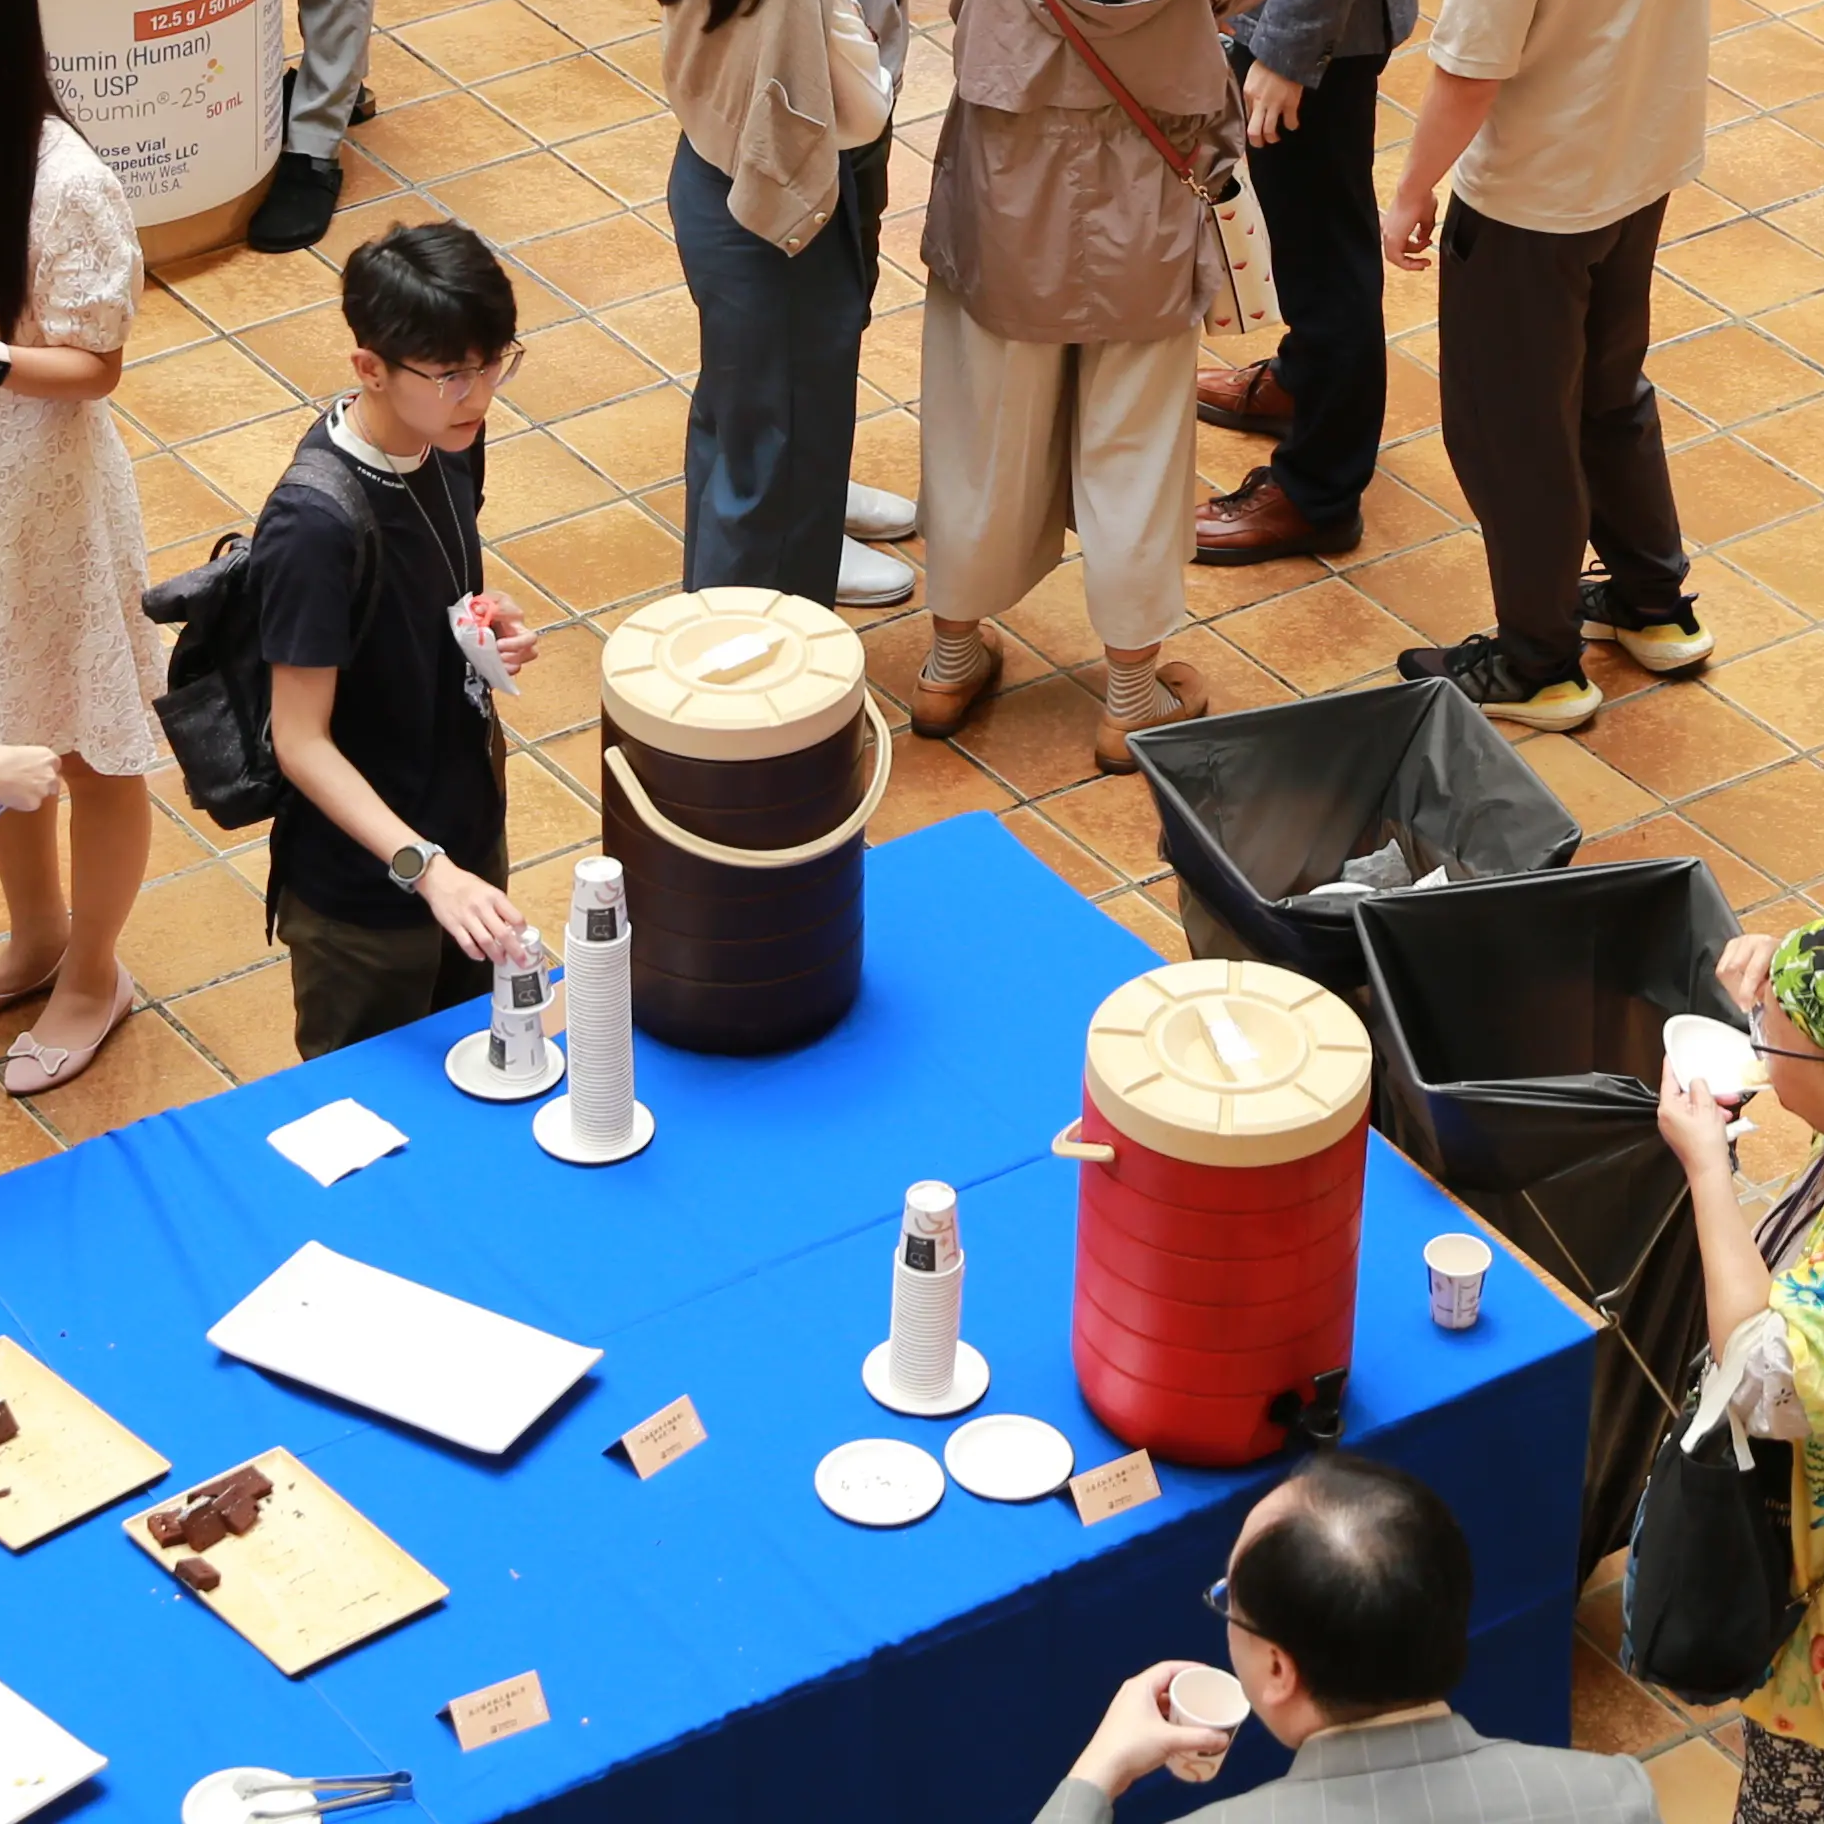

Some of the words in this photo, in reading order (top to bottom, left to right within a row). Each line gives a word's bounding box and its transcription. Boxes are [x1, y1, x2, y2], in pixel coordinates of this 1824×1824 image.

[150, 12, 182, 31] 12.5
[185, 11, 196, 25] g
[47, 51, 117, 73] bumin
[126, 30, 212, 72] (Human)
[93, 74, 139, 98] USP
[66, 83, 207, 123] sbumin®-25
[206, 101, 222, 119] 50
[226, 91, 243, 111] mL
[106, 154, 172, 173] rapeutics
[175, 143, 200, 160] LLC
[136, 137, 166, 153] Vial
[130, 166, 156, 185] Hwy
